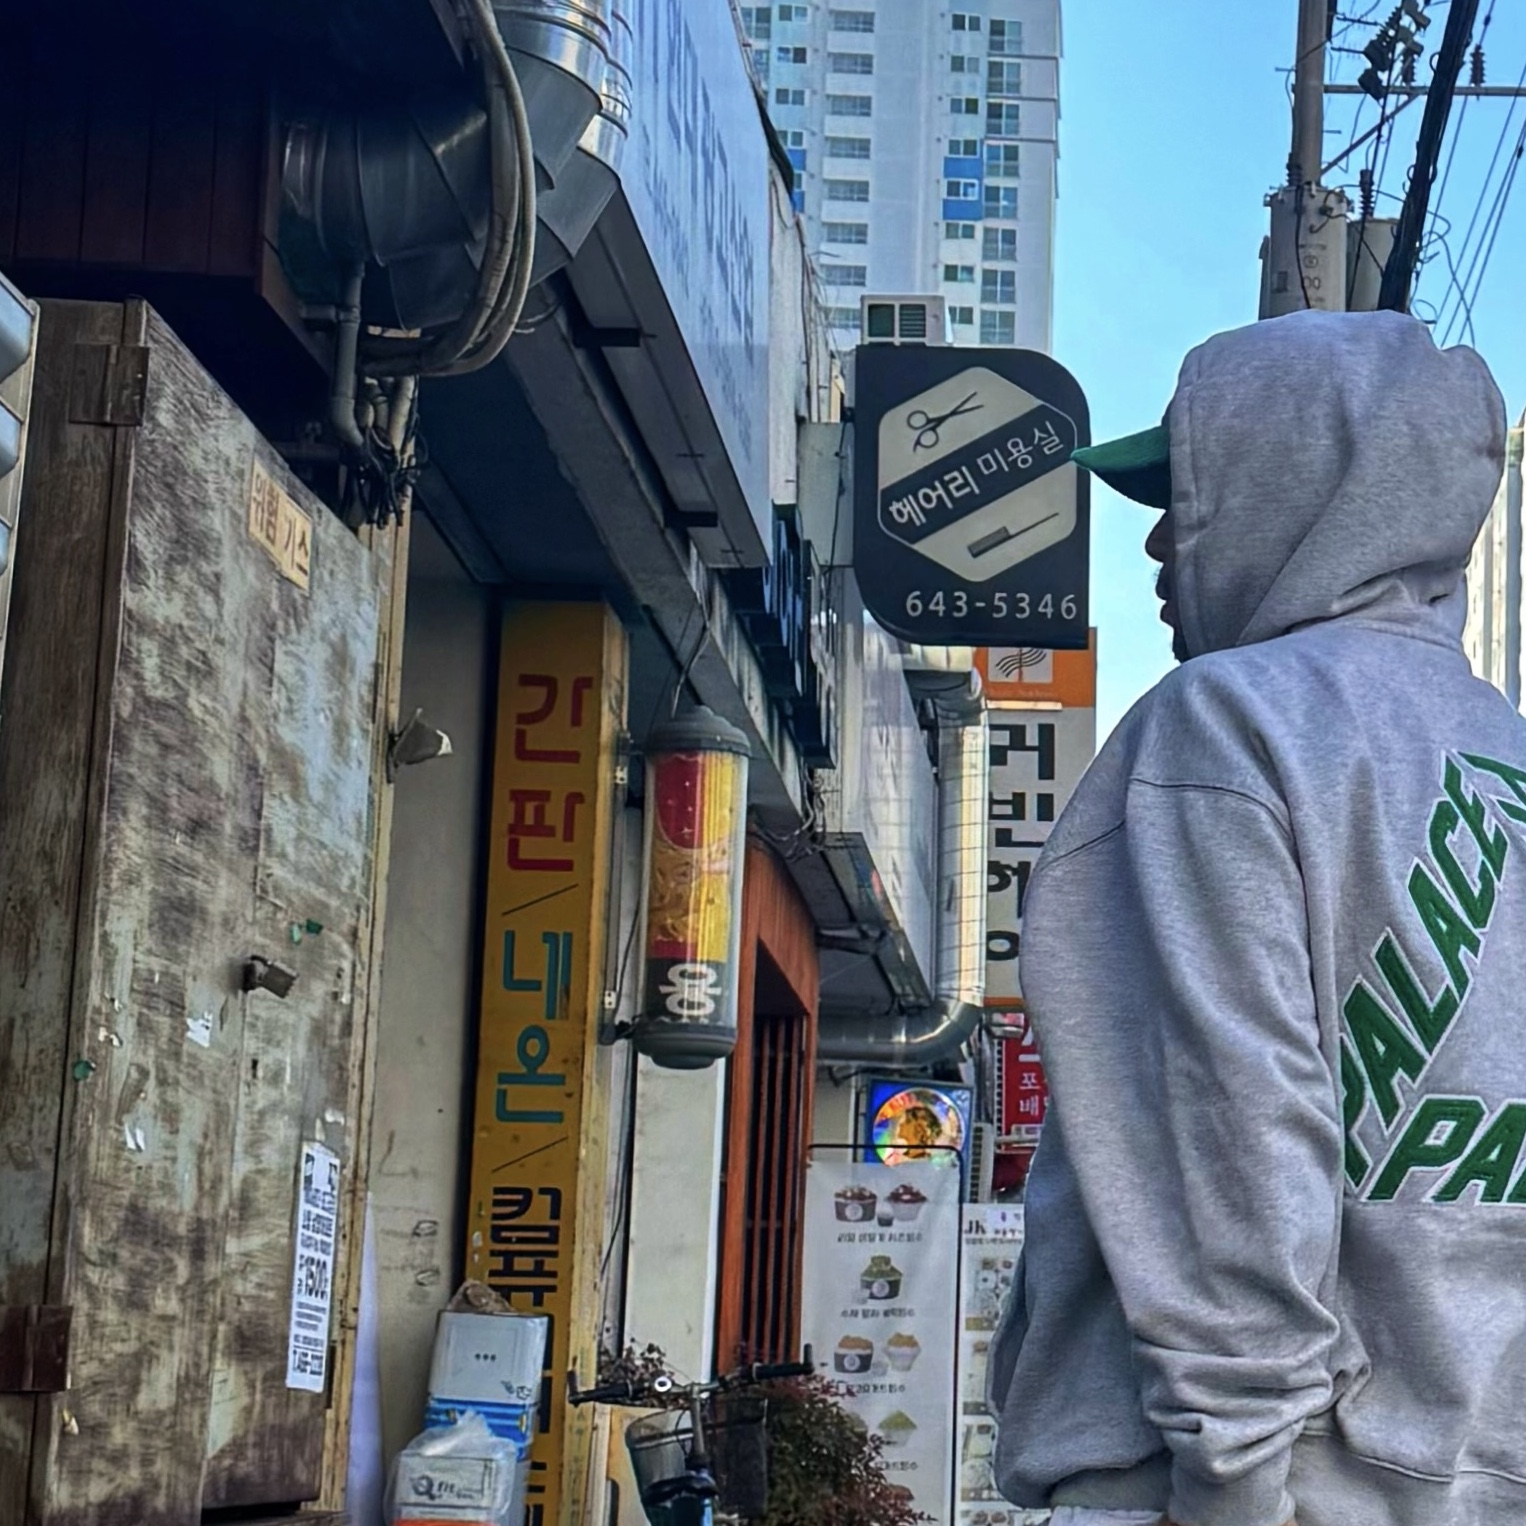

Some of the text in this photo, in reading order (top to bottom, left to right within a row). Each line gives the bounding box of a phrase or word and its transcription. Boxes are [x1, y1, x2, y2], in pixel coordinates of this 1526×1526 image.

[976, 420, 1064, 475] 미용실
[905, 591, 1078, 621] 643-5346
[507, 673, 594, 873] 간판
[496, 929, 573, 1123] 네온
